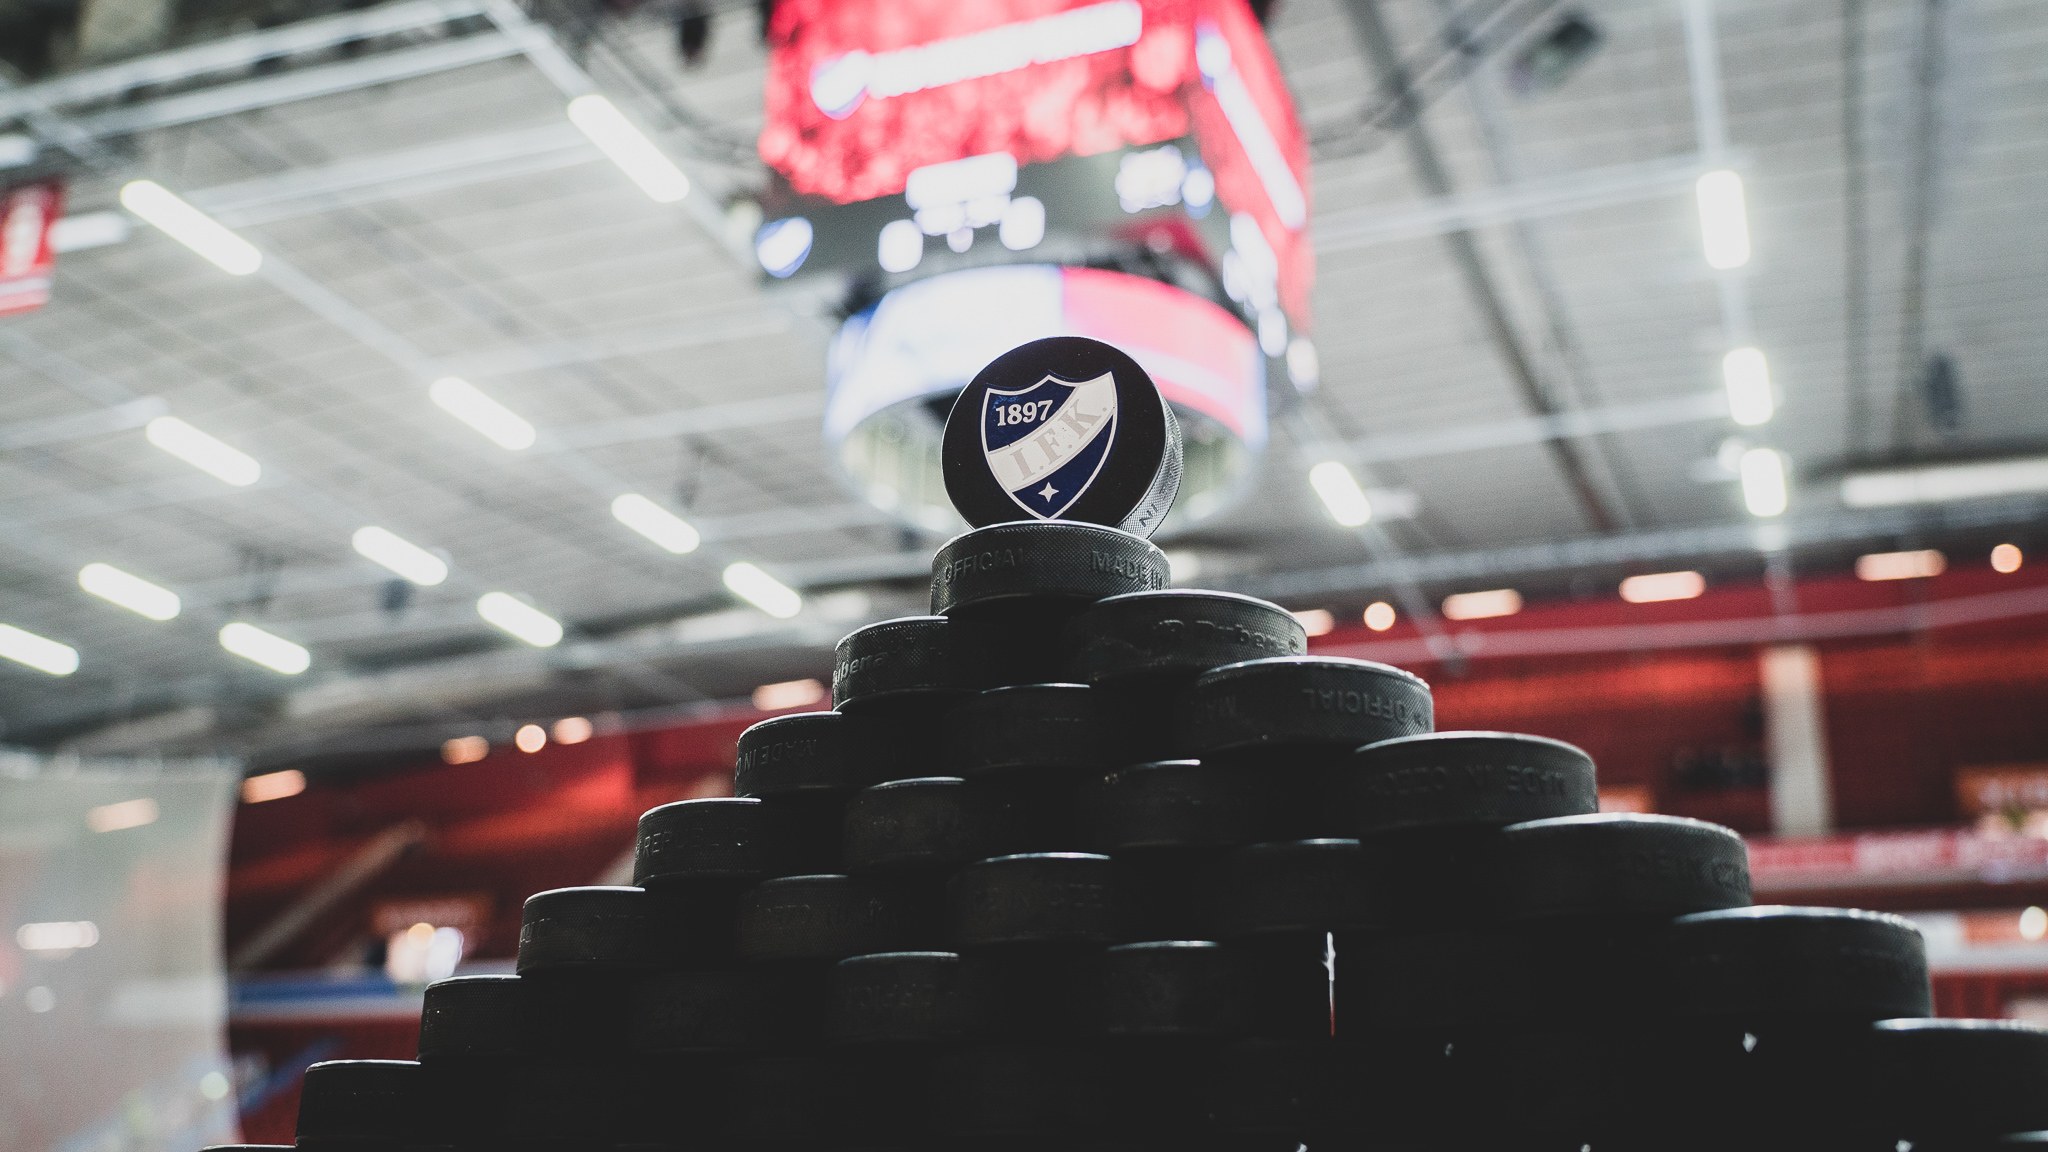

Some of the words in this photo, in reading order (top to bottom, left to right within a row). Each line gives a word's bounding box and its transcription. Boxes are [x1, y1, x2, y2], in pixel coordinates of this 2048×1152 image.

[995, 399, 1054, 427] 1897
[1092, 550, 1148, 585] MADE
[1301, 688, 1406, 725] OFFICIAL
